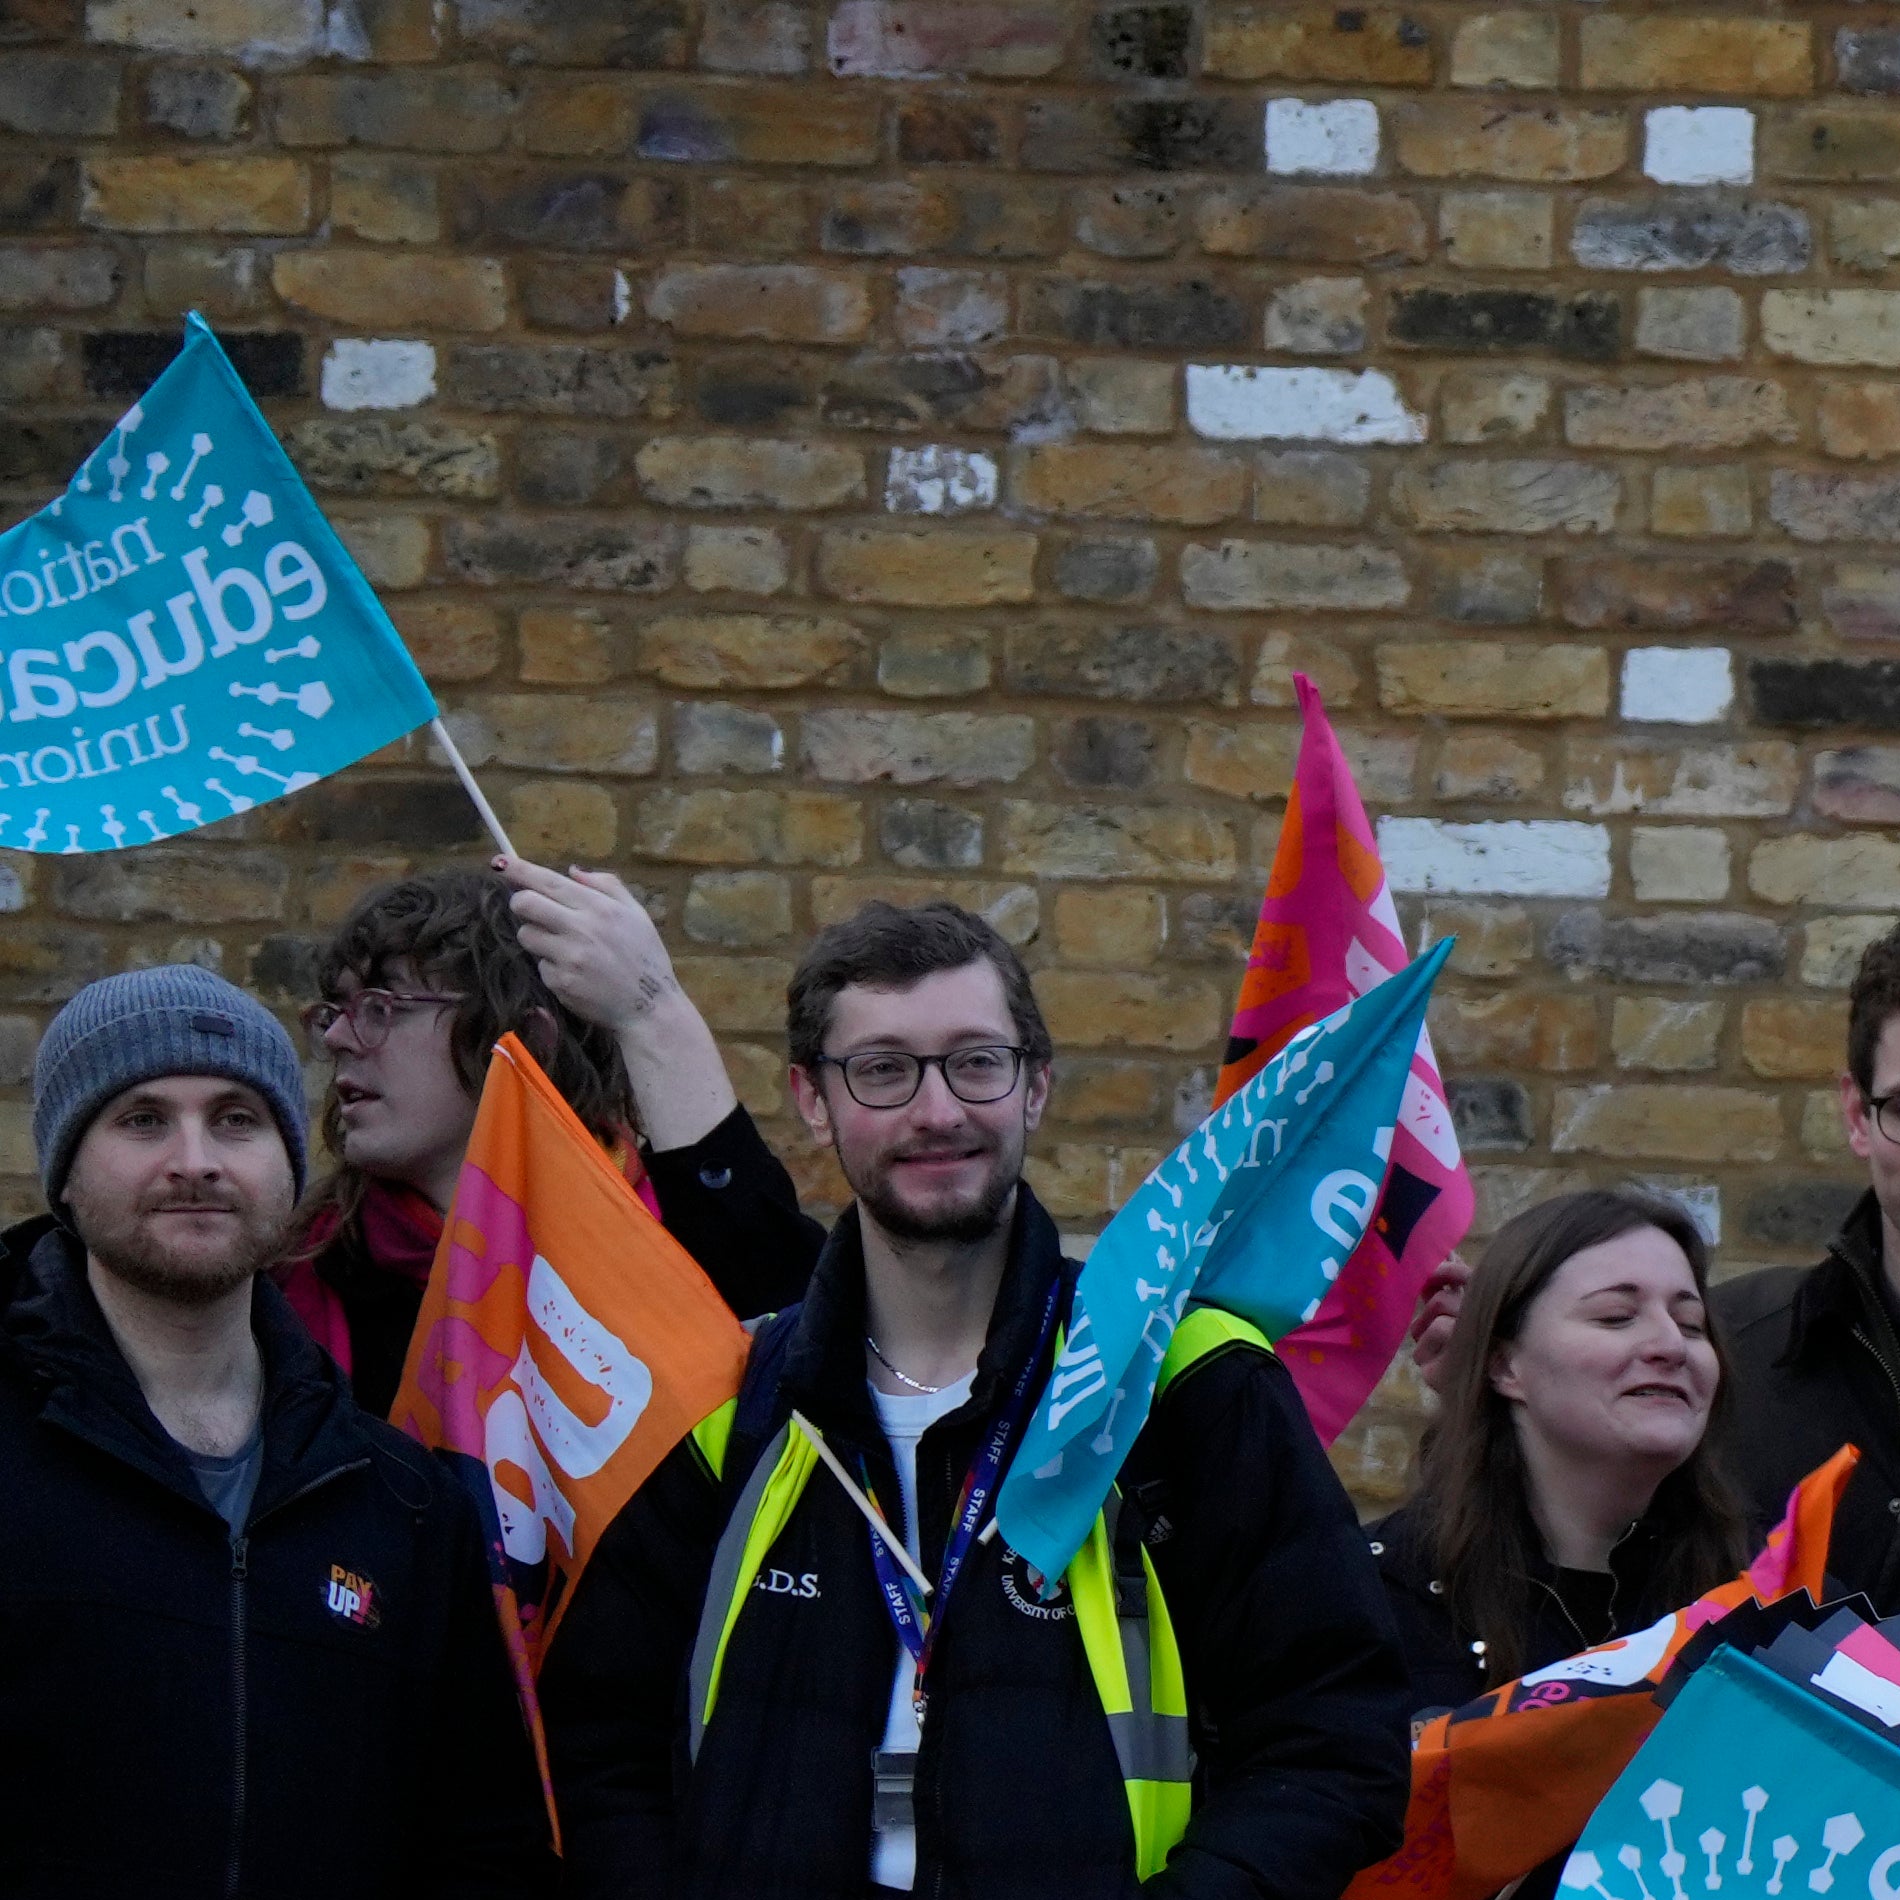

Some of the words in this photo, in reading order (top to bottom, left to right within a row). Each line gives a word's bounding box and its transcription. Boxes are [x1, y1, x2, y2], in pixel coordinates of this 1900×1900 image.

[987, 1419, 1011, 1465] STAFF
[961, 1487, 986, 1533] STAFF
[331, 1563, 373, 1597] PAY
[1002, 1574, 1051, 1620] UNIVERSITY
[1050, 1606, 1067, 1620] OF
[885, 1582, 912, 1625] STAFF
